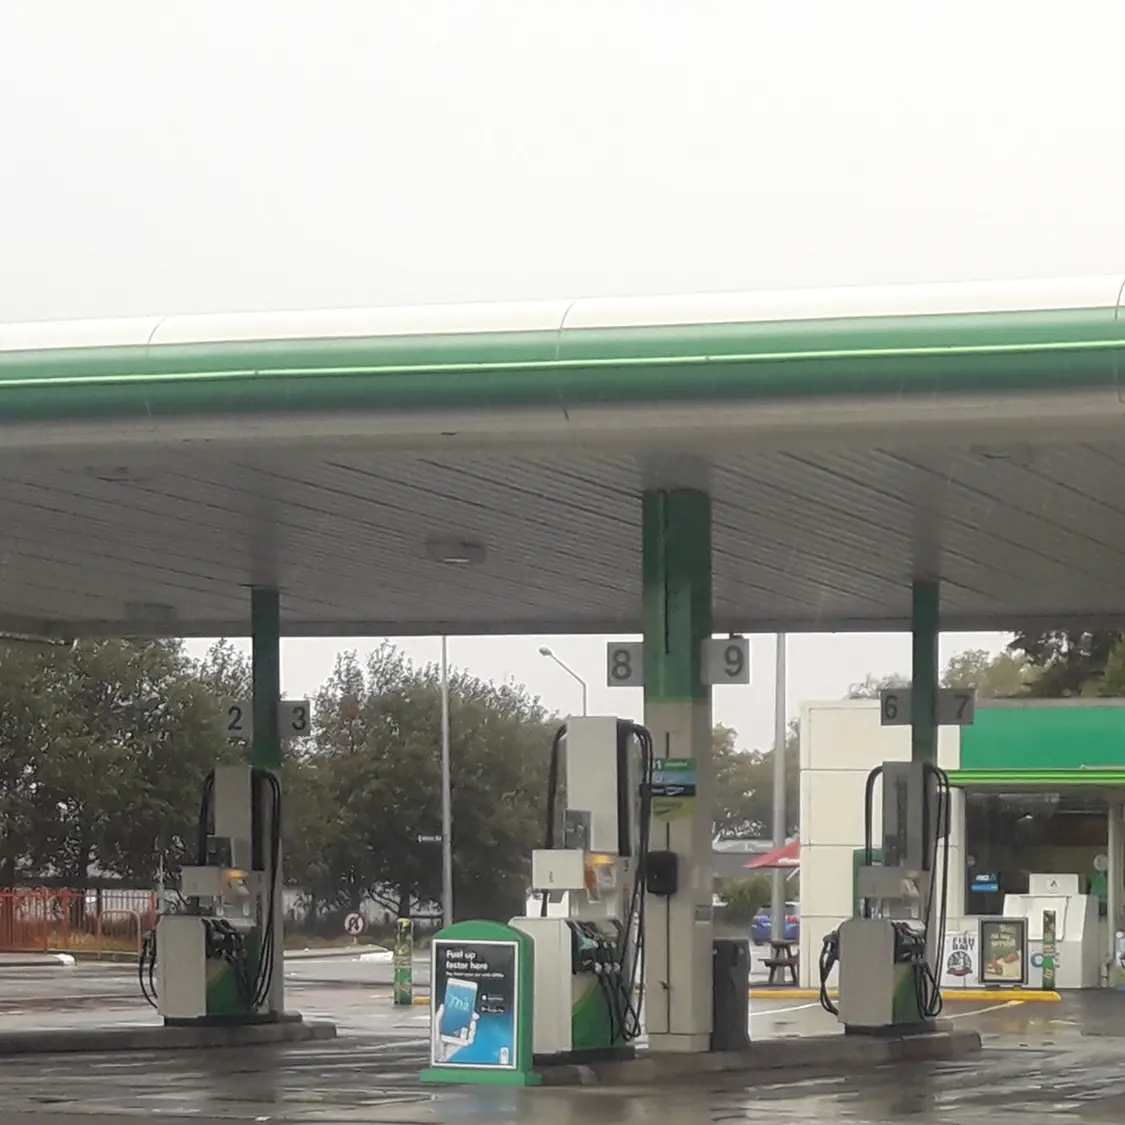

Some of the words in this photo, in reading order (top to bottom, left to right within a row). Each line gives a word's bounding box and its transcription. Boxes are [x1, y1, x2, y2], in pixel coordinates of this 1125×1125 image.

[611, 649, 632, 680] 8
[724, 645, 744, 677] 9
[227, 705, 242, 731] 2
[291, 706, 306, 731] 3
[884, 695, 898, 719] 6
[955, 694, 970, 719] 7
[446, 949, 464, 959] Fuel
[464, 952, 476, 961] up
[446, 961, 468, 970] faster
[470, 960, 488, 970] here
